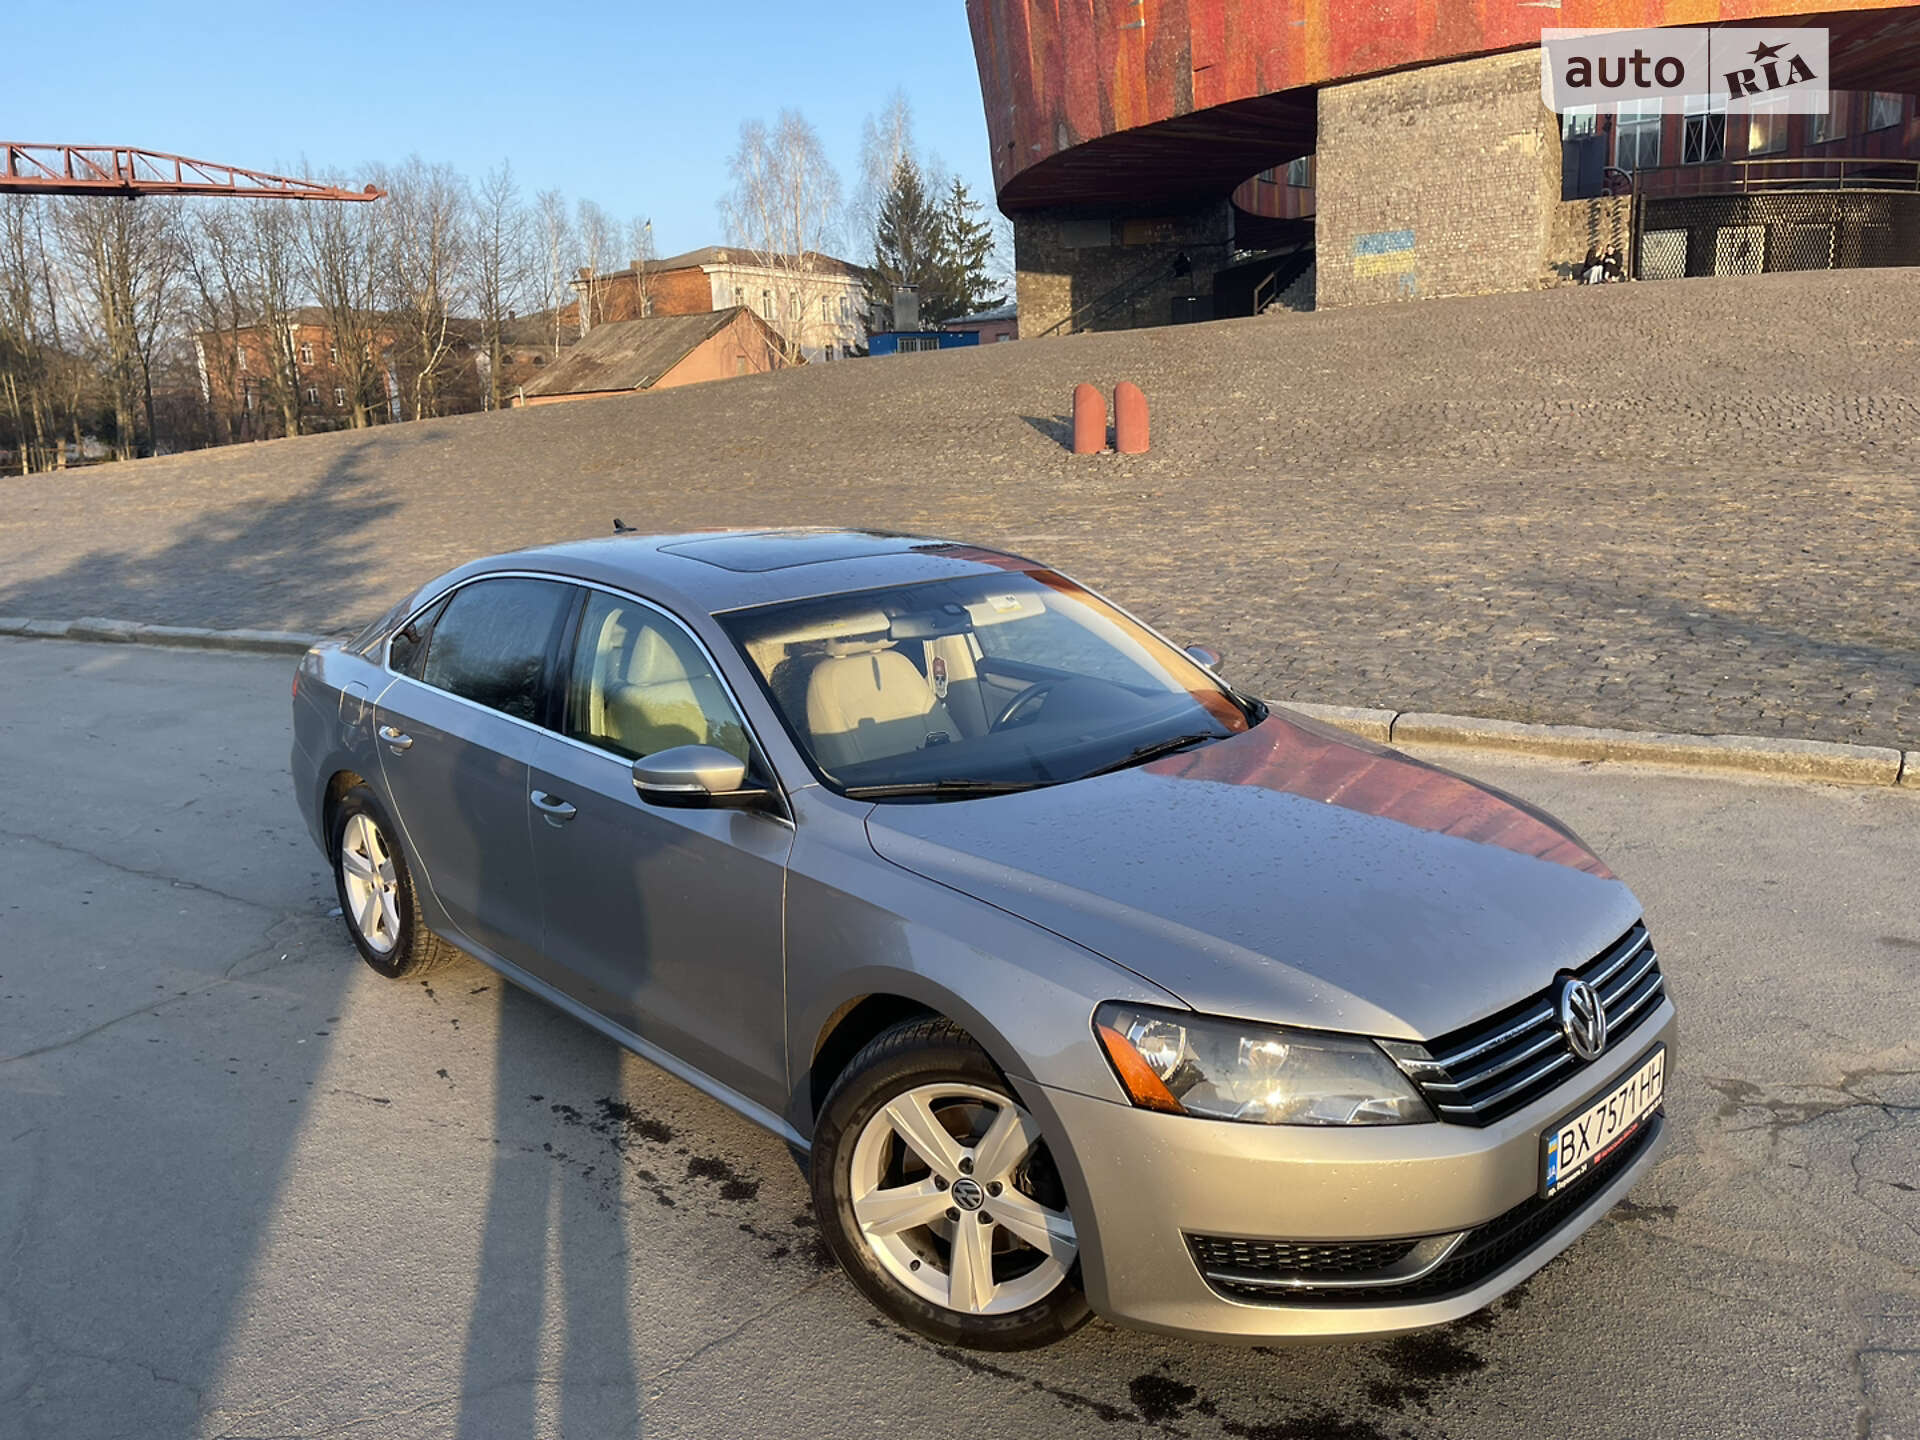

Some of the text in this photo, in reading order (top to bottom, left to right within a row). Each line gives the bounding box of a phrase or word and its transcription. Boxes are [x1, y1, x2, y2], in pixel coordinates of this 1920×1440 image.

[1560, 1115, 1592, 1169] BX
[1596, 1082, 1636, 1145] 7571
[1639, 1055, 1661, 1107] HH
